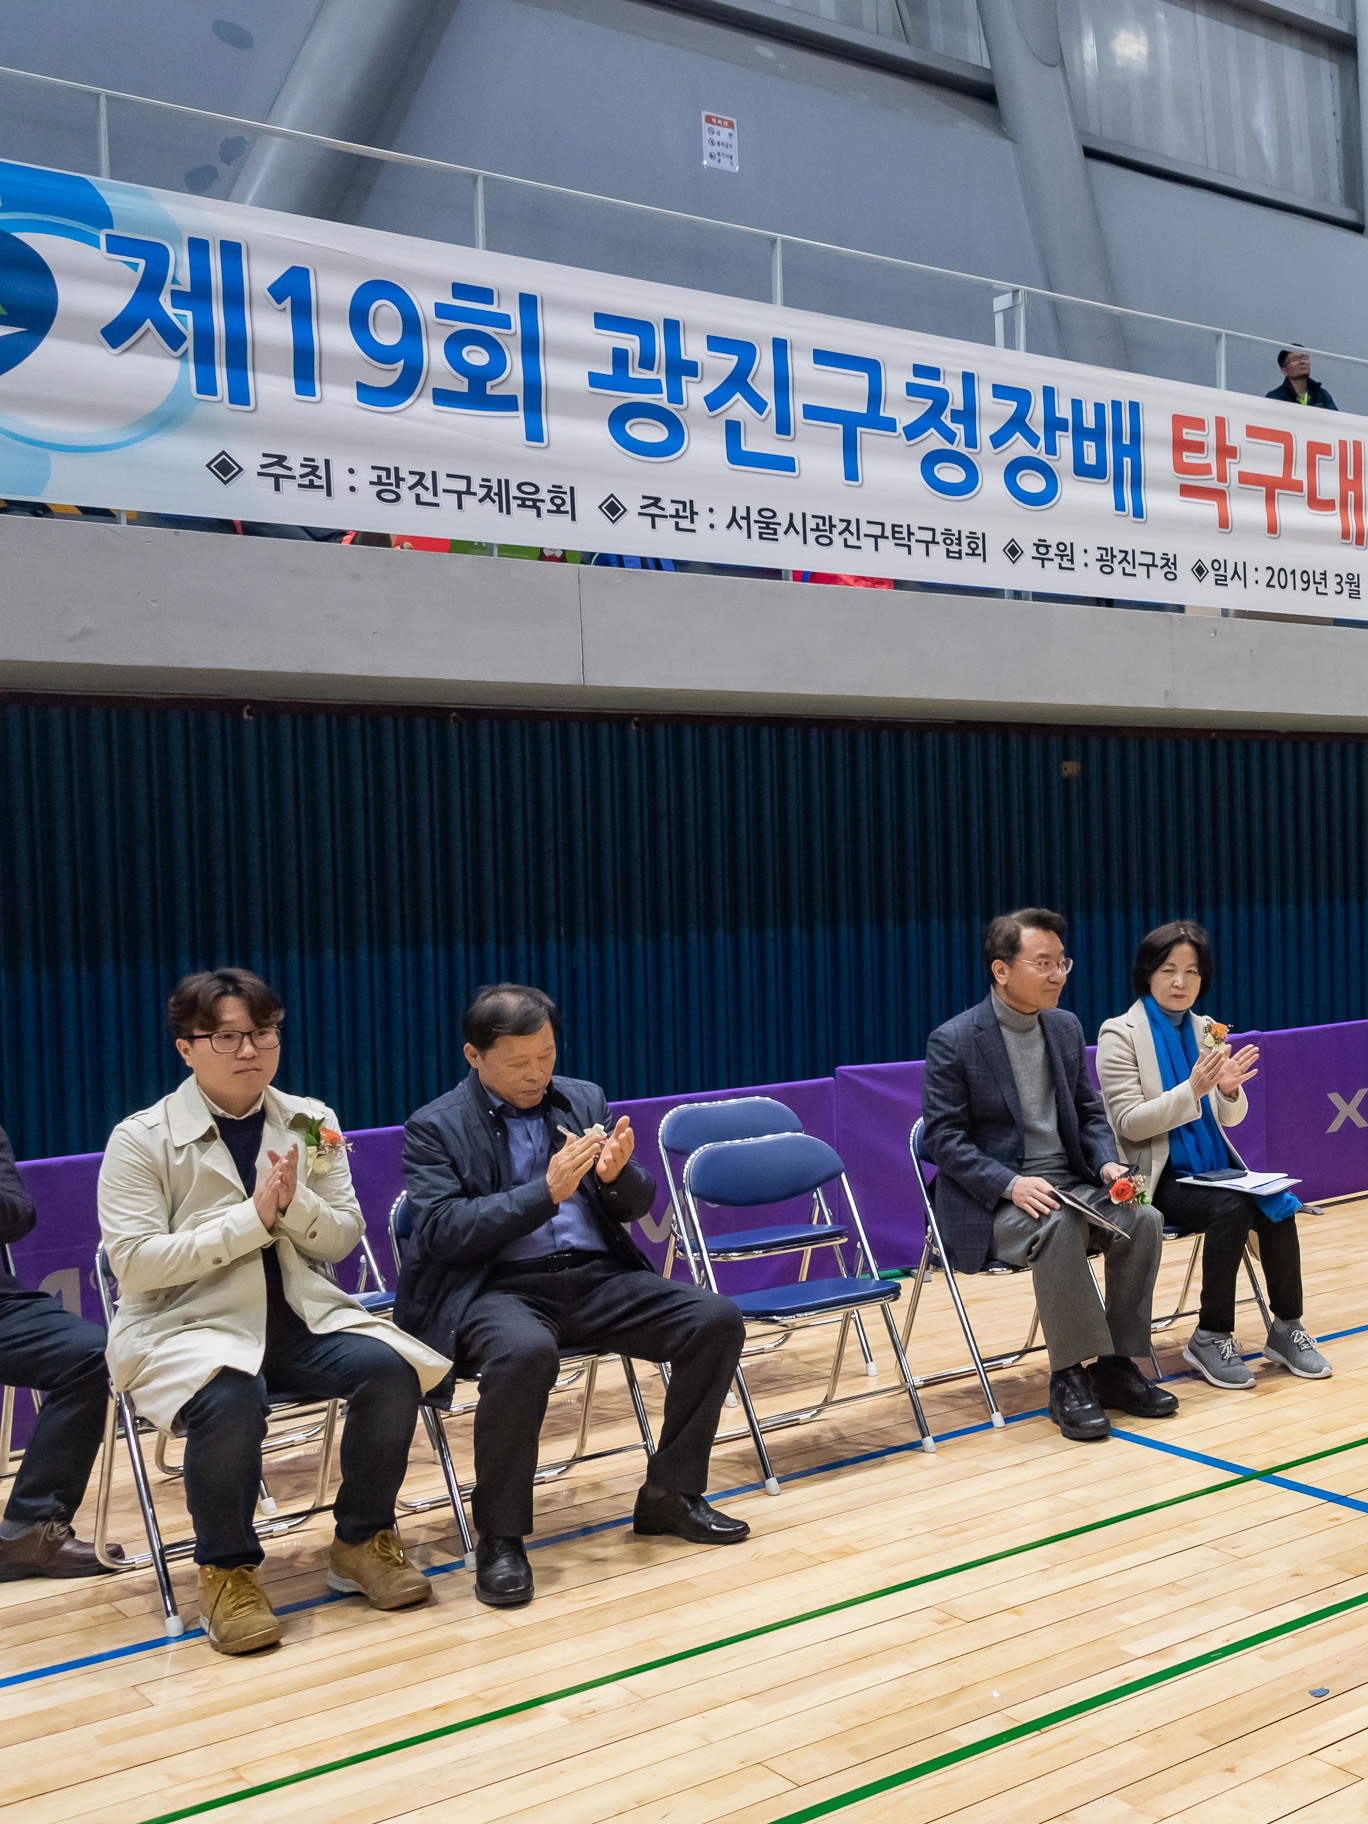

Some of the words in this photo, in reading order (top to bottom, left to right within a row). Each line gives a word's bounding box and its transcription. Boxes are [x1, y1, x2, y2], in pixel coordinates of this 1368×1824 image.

[100, 233, 546, 443] 제19회
[588, 312, 1145, 519] 광진구청장배
[256, 452, 333, 498] 주최
[368, 465, 578, 522] 광진구체육회
[637, 495, 699, 534] 주관
[725, 505, 988, 563] 서울시광진구탁구협회
[1031, 540, 1075, 572] 후원
[1095, 545, 1178, 583] 광진구청
[1210, 557, 1248, 589] 일시
[1265, 566, 1329, 597] 2019년
[1334, 572, 1362, 601] 3월
